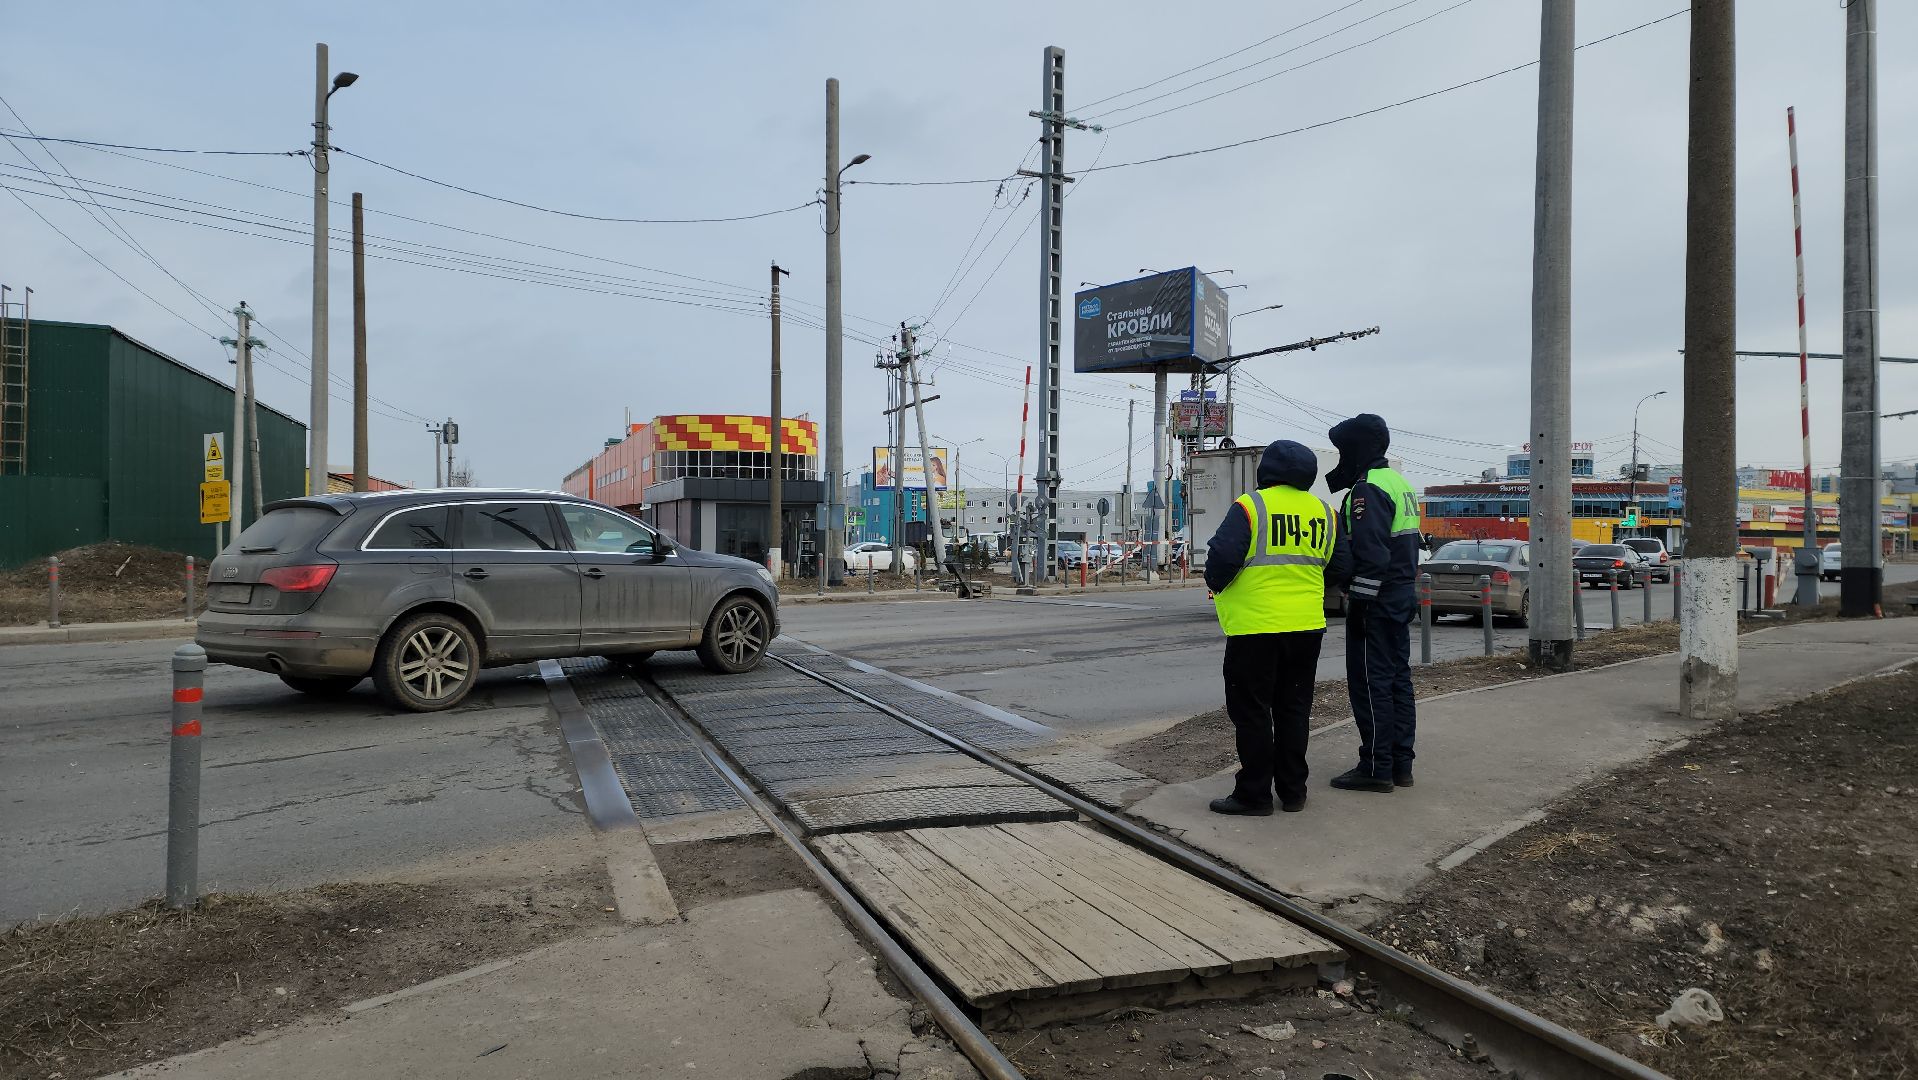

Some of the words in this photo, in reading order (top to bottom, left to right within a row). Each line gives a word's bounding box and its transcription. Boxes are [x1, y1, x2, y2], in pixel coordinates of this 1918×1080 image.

[1106, 305, 1152, 321] Стальные
[1107, 311, 1172, 339] КРОВЛИ
[1271, 513, 1326, 550] ПЧ-17
